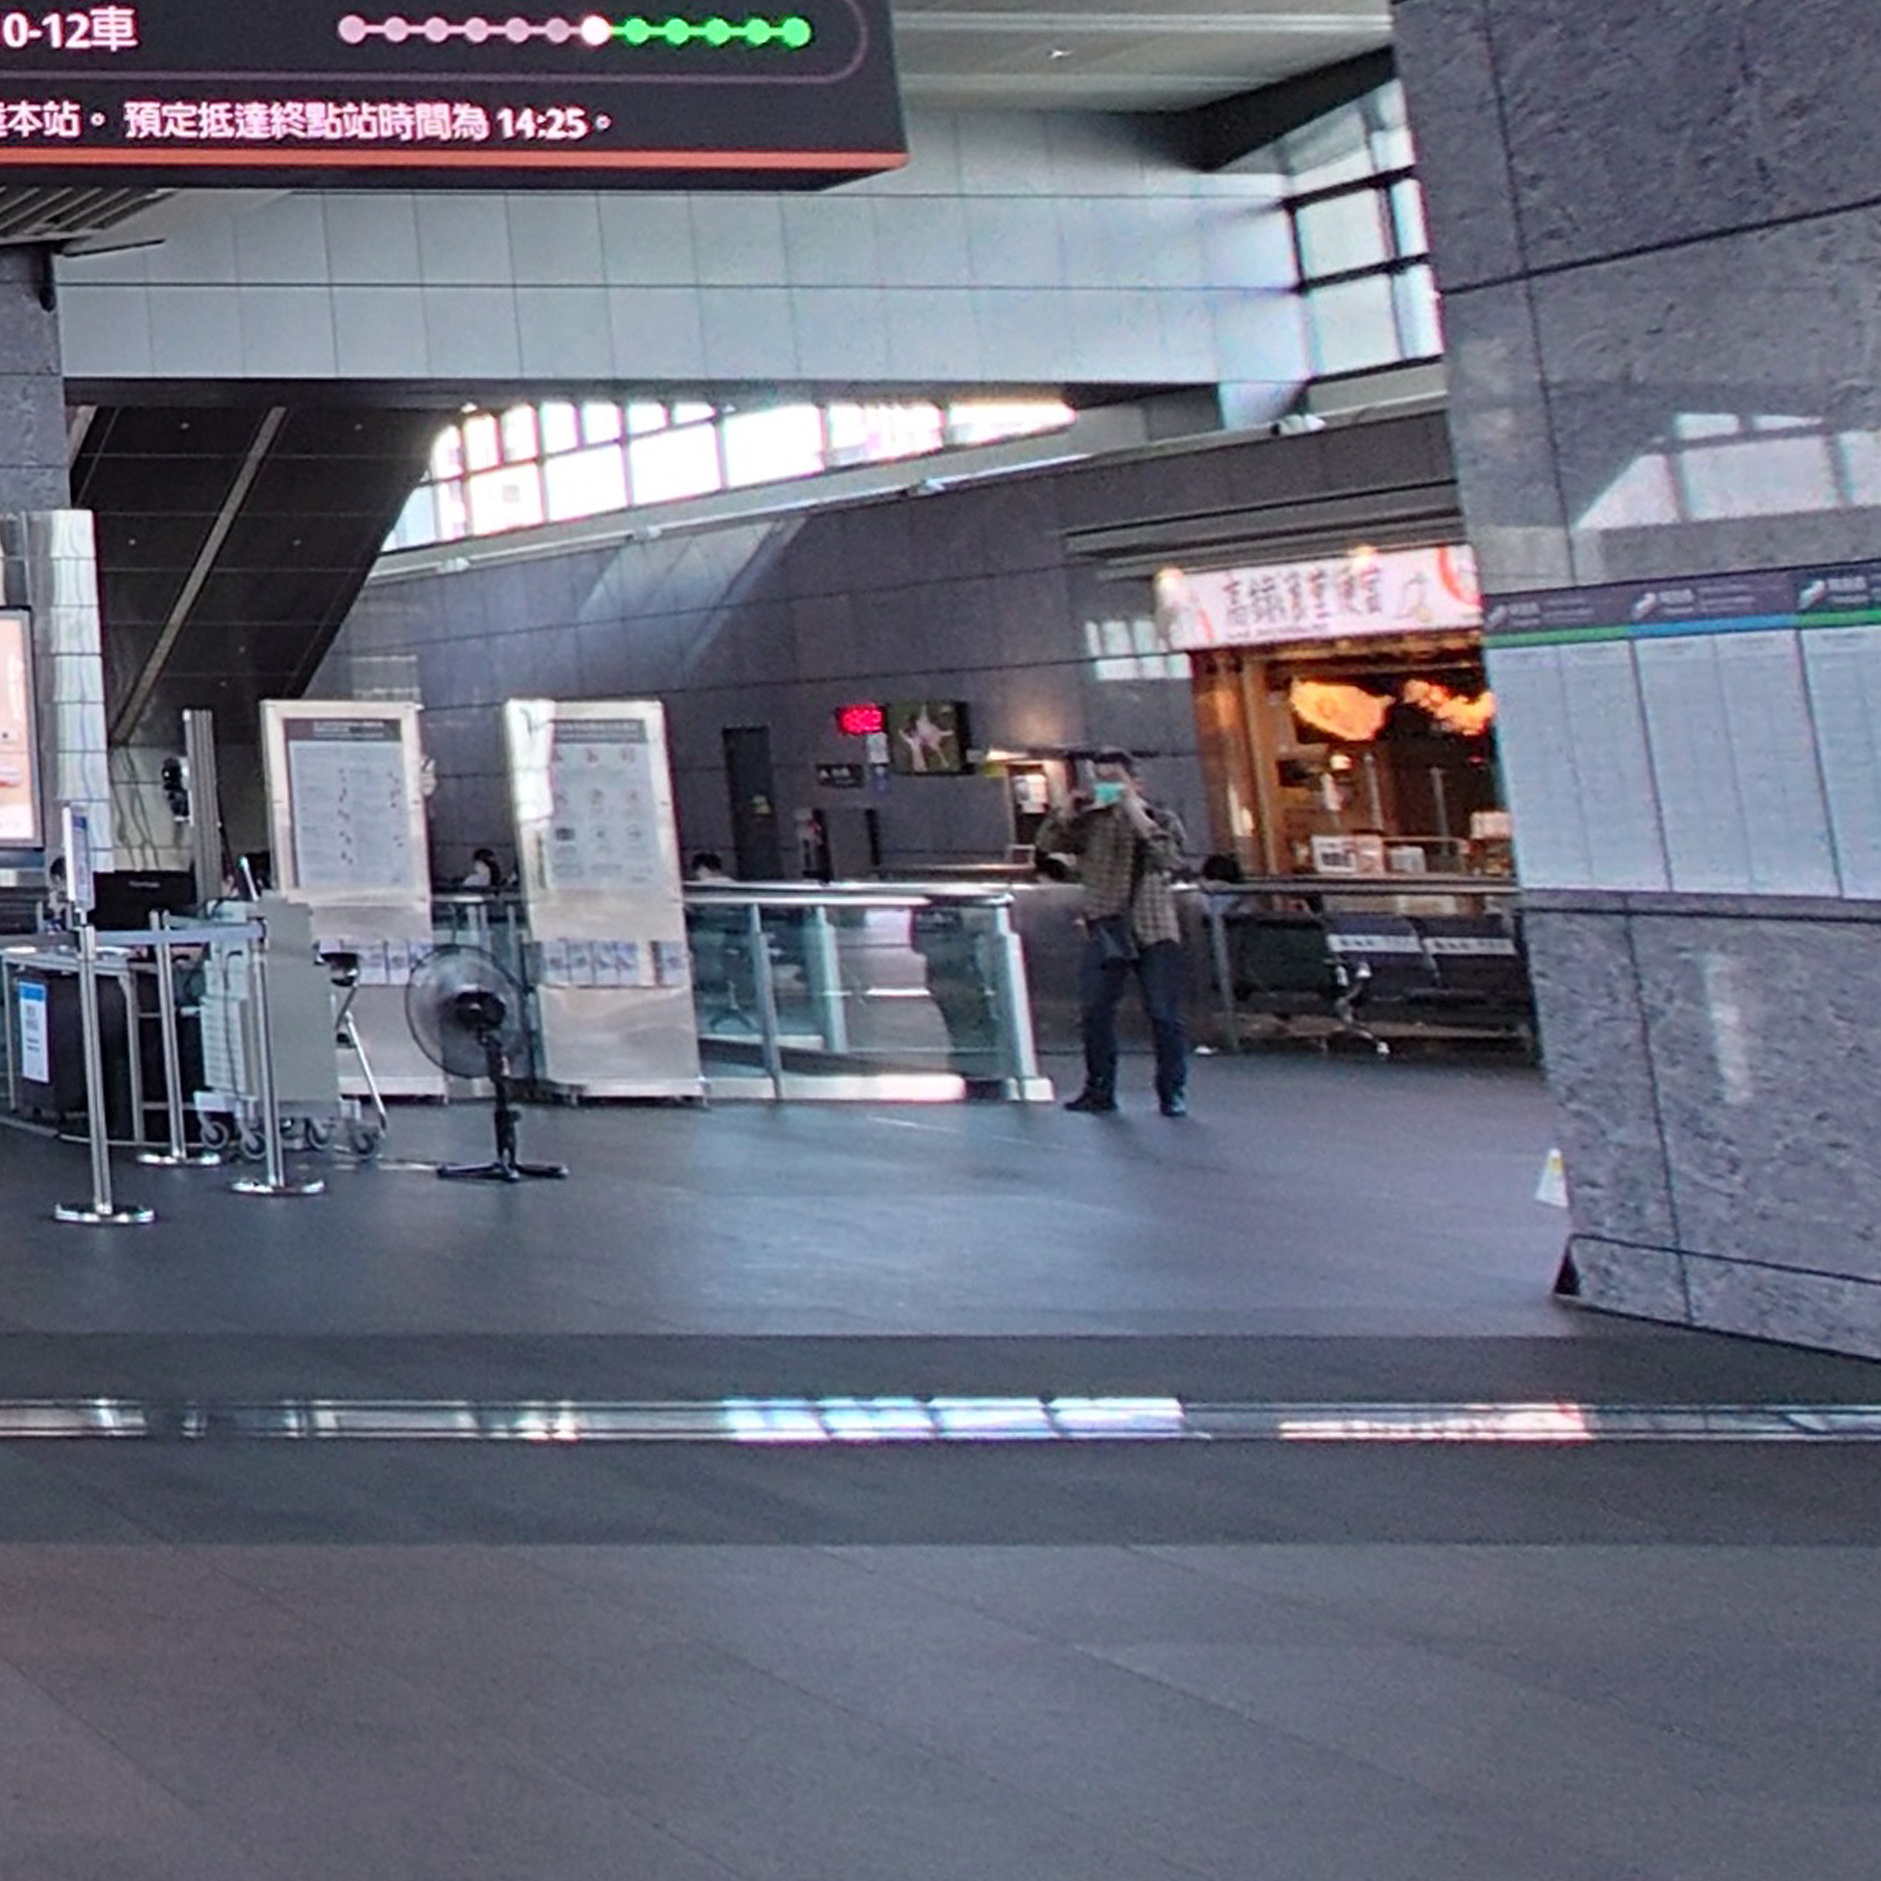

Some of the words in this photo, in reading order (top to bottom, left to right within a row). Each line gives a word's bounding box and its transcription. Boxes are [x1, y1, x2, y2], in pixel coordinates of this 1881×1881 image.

[123, 100, 490, 141] 預定抵達終點站時間為
